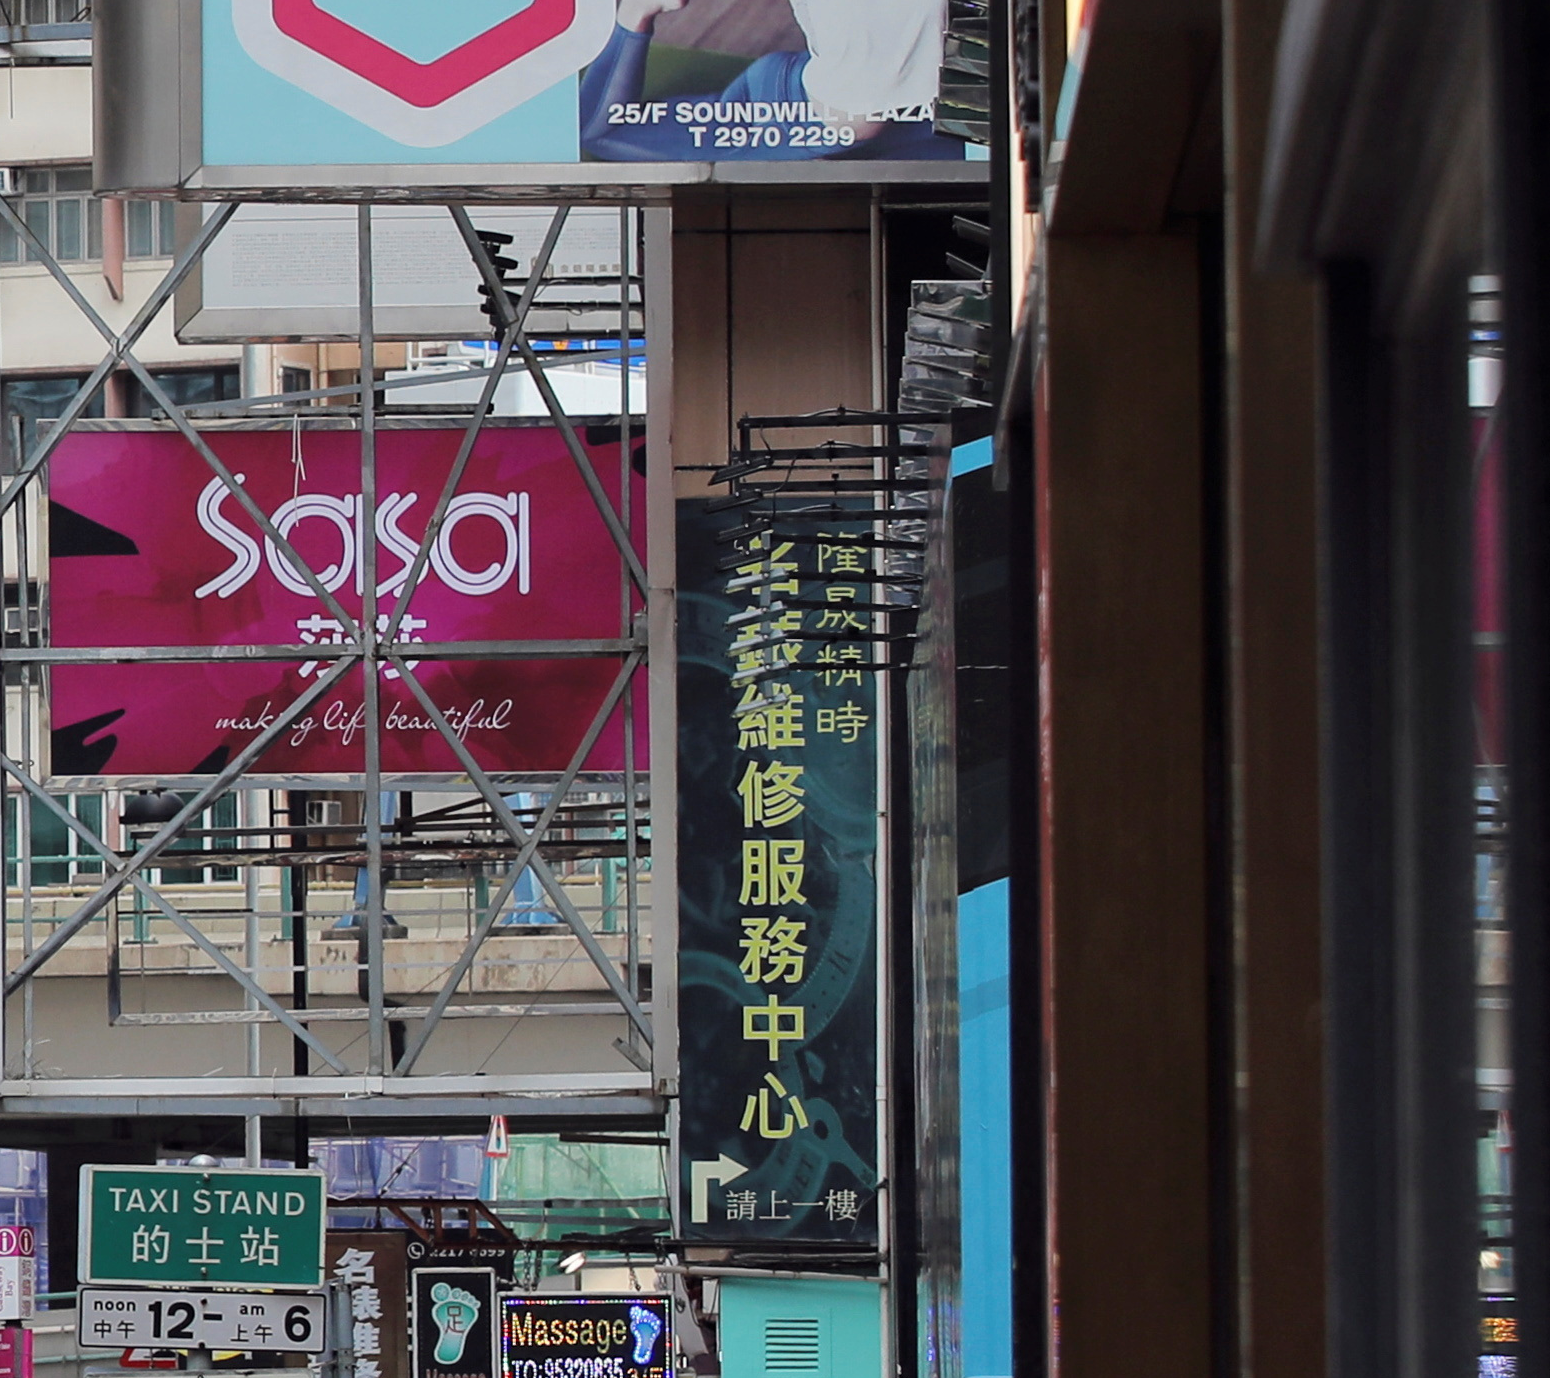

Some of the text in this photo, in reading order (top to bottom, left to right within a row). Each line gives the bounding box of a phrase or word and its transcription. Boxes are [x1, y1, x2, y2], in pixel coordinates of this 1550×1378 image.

[607, 102, 668, 125] 25/F
[688, 126, 856, 148] T 2970 2299
[323, 700, 367, 746] lif
[108, 1187, 306, 1217] TAXI STAND
[725, 1189, 861, 1223] 請上一樓
[132, 1224, 280, 1267] 的士站
[93, 1299, 137, 1313] noon
[239, 1302, 265, 1316] am
[284, 1305, 312, 1343] 6
[93, 1319, 274, 1344] 中午 上午
[511, 1311, 628, 1354] Massage
